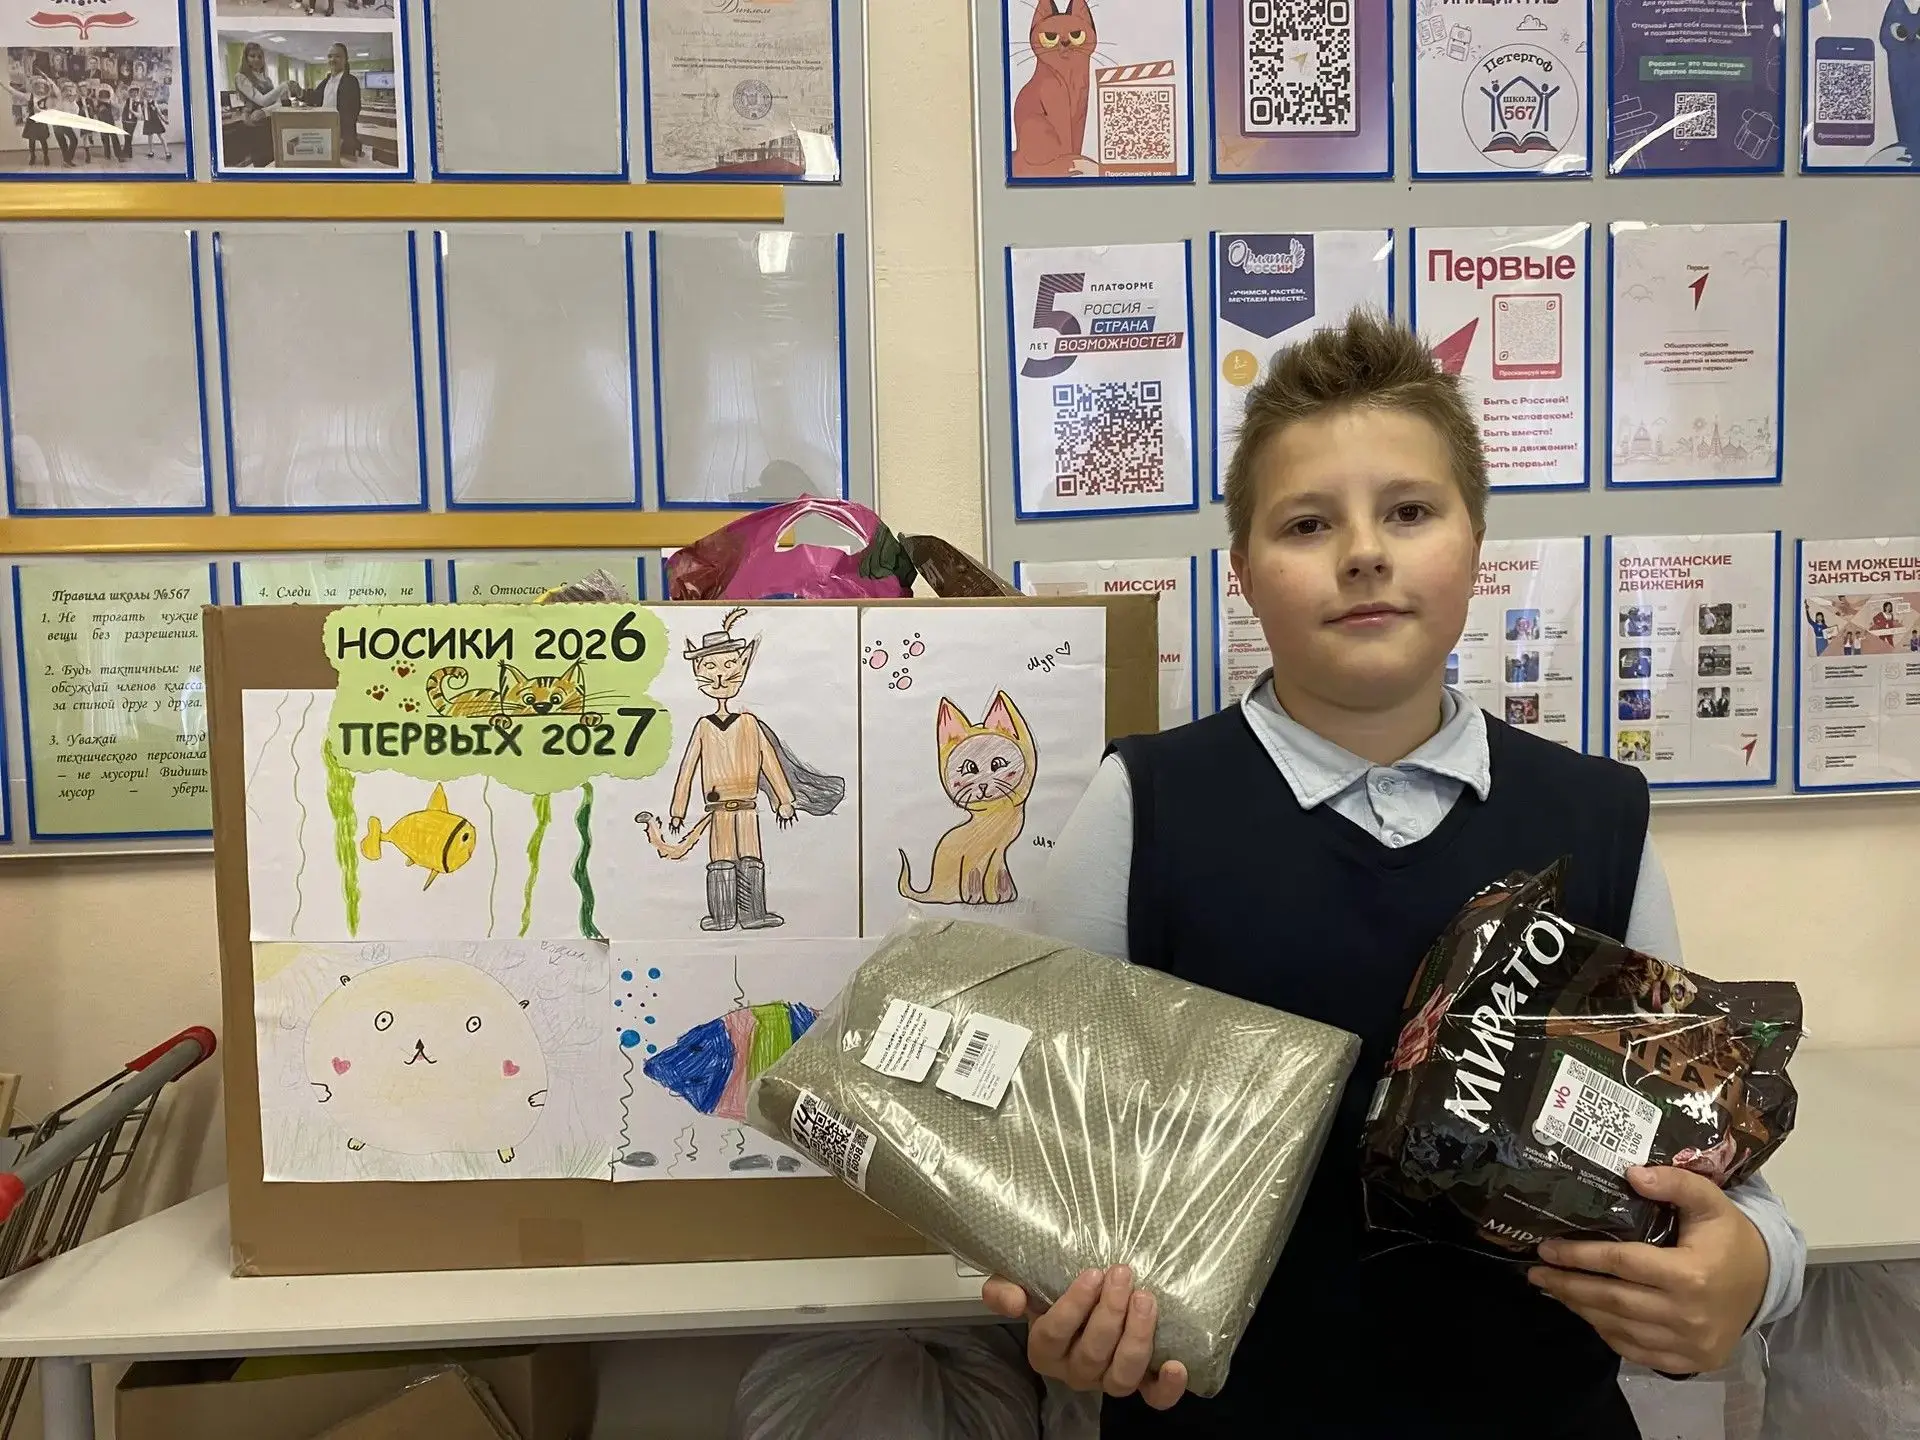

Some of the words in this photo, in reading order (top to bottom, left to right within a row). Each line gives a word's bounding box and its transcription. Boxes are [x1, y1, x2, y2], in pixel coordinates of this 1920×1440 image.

[1483, 52, 1553, 73] Петергоф
[1503, 95, 1537, 103] школа
[1504, 106, 1536, 120] 567
[1428, 249, 1576, 289] Первые
[1090, 281, 1154, 292] ПЛАТФОРМЕ
[1084, 302, 1141, 316] РОССИЯ
[1020, 273, 1086, 378] 5
[1094, 320, 1149, 333] СТРАНА
[1029, 342, 1048, 351] ЛЕТ
[1058, 333, 1177, 351] ВОЗМОЖНОСТЕЙ
[1483, 397, 1510, 405] Быть
[1483, 429, 1510, 437] Быть
[1479, 560, 1540, 571] АНСКИЕ
[1619, 555, 1732, 568] ФЛАГМАНСКИЕ
[1808, 560, 1842, 572] ЧЕМ
[1477, 573, 1497, 584] ТЫ
[1619, 568, 1690, 579] ПРОЕКТЫ
[1808, 570, 1891, 585] ЗАНЯТЬСЯ
[258, 587, 269, 598] 4.
[276, 586, 311, 599] Следи
[324, 588, 336, 597] за
[349, 586, 387, 600] речью,
[400, 587, 413, 596] не
[472, 584, 482, 596] 8.
[490, 584, 548, 596] Относись
[1104, 579, 1176, 593] МИССИЯ
[1472, 584, 1511, 596] ЕНИЯ
[1618, 579, 1704, 593] ДВИЖЕНИЯ
[51, 589, 106, 602] Правила
[109, 589, 150, 602] школы
[153, 588, 190, 601] №567
[40, 613, 50, 624] 1.
[57, 612, 76, 624] Не
[92, 613, 145, 625] трогать
[161, 612, 199, 624] чужие
[47, 631, 78, 643] вещи
[92, 628, 111, 640] без
[124, 629, 199, 643] разрешения.
[338, 626, 514, 661] НОСИКИ
[534, 611, 647, 662] 2026
[1028, 654, 1056, 672] Мур
[1160, 653, 1180, 663] МИ
[44, 665, 54, 676] 2.
[62, 664, 92, 677] Будь
[100, 664, 179, 676] тактичным:
[188, 663, 202, 673] не
[51, 681, 109, 695] обсуждай
[117, 682, 156, 692] членов
[164, 681, 202, 692] класса
[52, 702, 66, 711] за
[73, 698, 115, 710] спиной
[121, 698, 148, 711] друг
[167, 697, 203, 710] друга.
[338, 721, 522, 757] ПЕРВЫХ
[542, 707, 658, 757] 2027
[49, 735, 59, 746] 3.
[66, 733, 117, 747] Уважай
[175, 732, 206, 745] труд
[56, 751, 138, 765] технического
[147, 750, 207, 763] персонала
[77, 770, 91, 780] не
[100, 768, 149, 781] мусори!
[159, 766, 208, 778] Видишь
[58, 787, 95, 801] мусор
[171, 784, 208, 798] убери.
[1033, 836, 1056, 848] Мя
[1553, 1086, 1571, 1109] wb
[1628, 1133, 1643, 1155] 6306
[1483, 1218, 1544, 1244] МИРА
